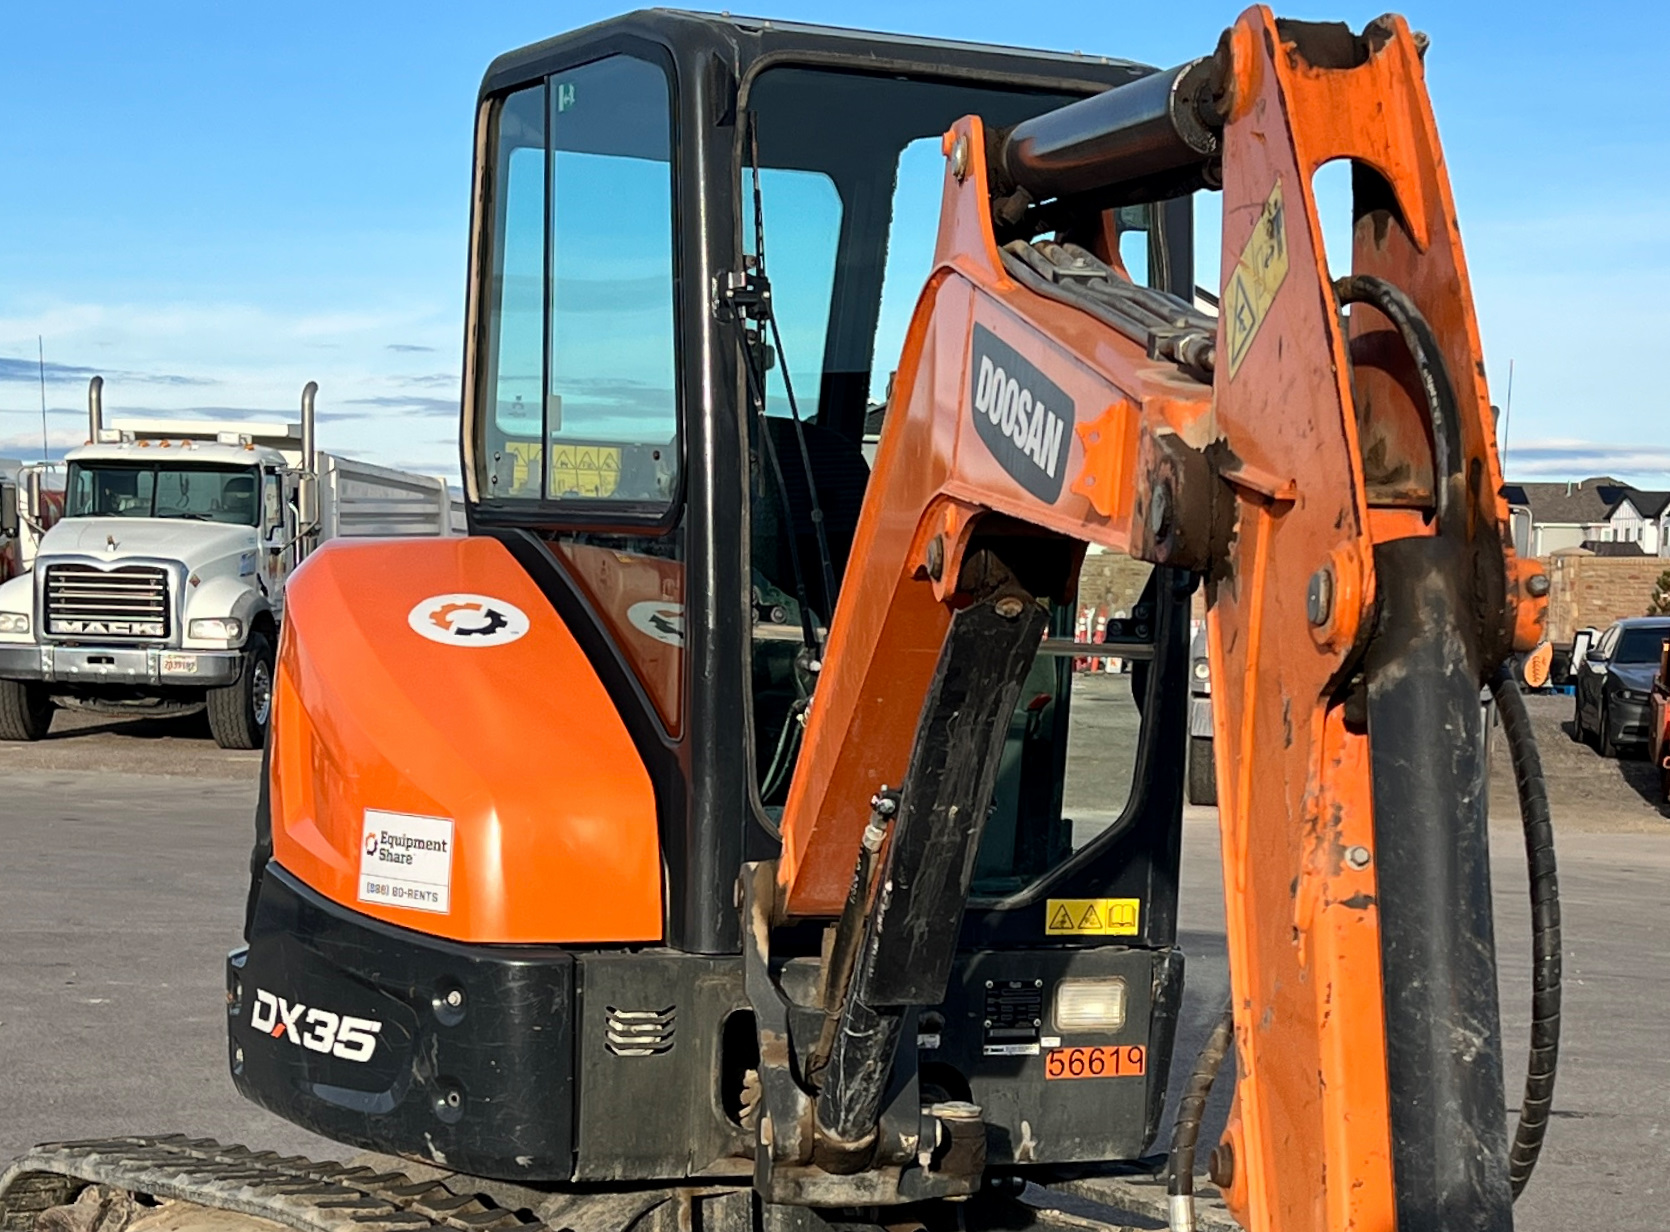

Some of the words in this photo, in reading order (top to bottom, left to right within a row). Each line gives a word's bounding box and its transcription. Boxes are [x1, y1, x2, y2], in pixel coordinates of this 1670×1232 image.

[975, 354, 1064, 479] DOOSAN
[57, 620, 154, 636] MACK
[380, 830, 447, 852] Equipment
[379, 848, 413, 865] Share
[251, 988, 382, 1062] DX35
[1048, 1046, 1144, 1076] 56619
